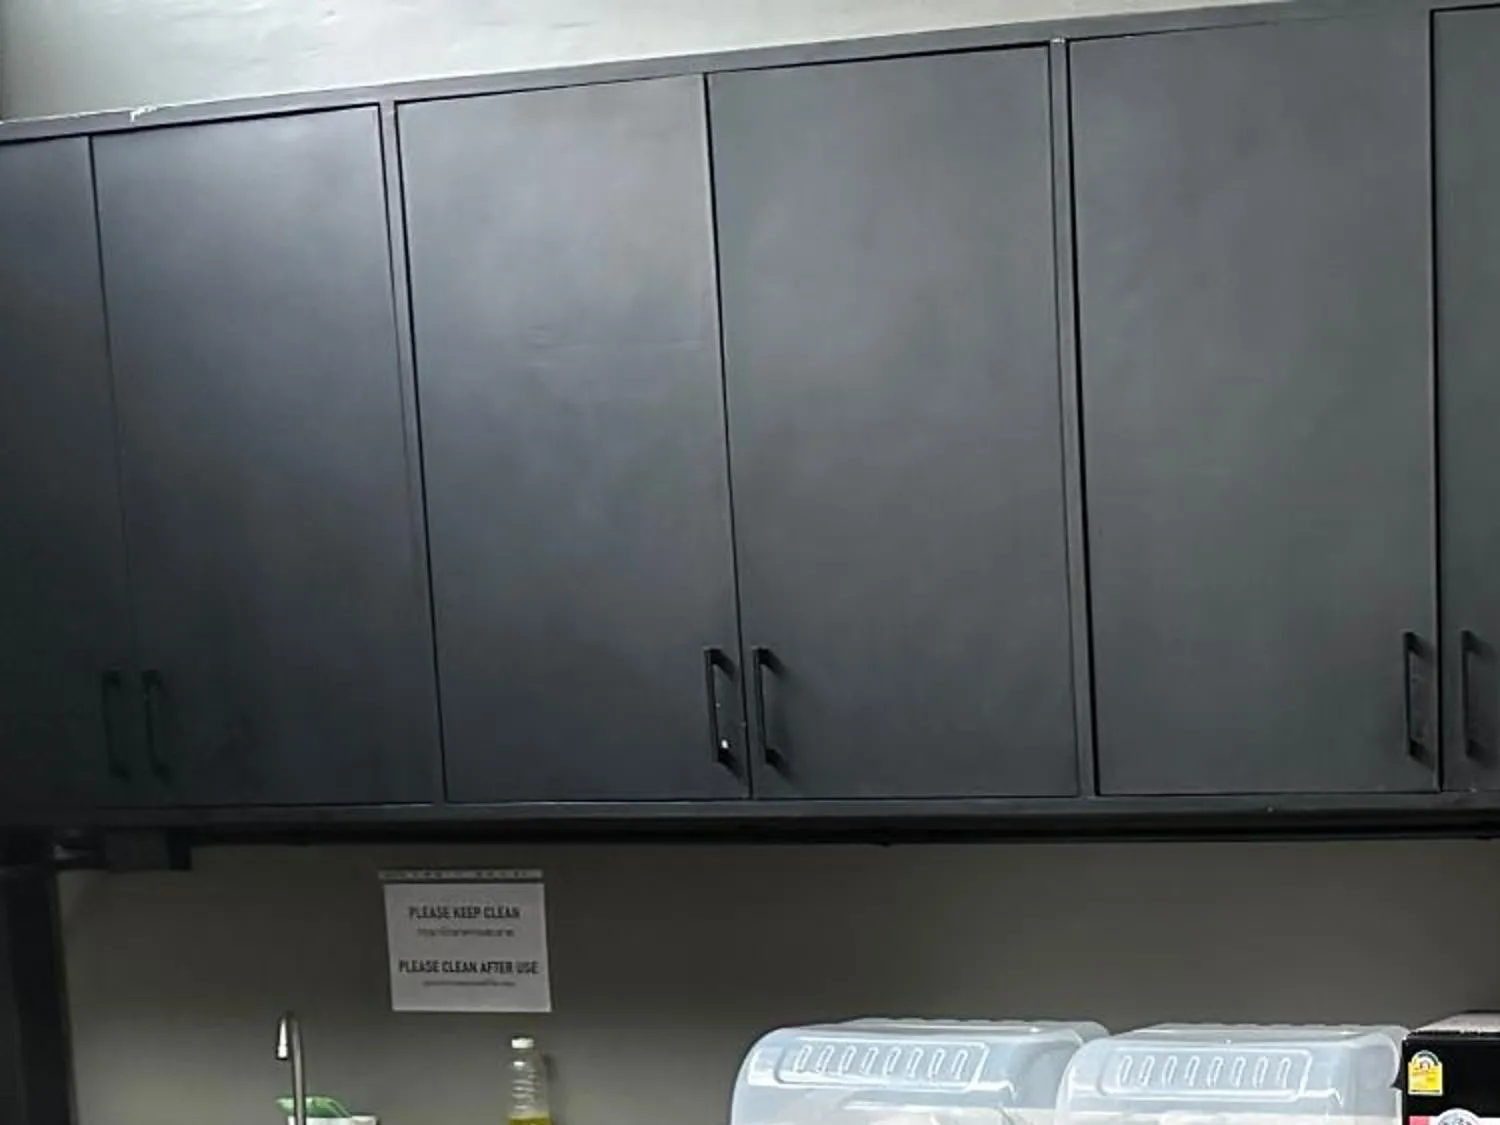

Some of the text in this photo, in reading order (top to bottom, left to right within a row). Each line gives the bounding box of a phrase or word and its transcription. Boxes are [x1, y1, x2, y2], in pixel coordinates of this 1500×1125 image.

[408, 905, 521, 920] PLEASE KEEP CLEAN
[399, 959, 539, 974] PLEASE CLEAN AFTER USE
